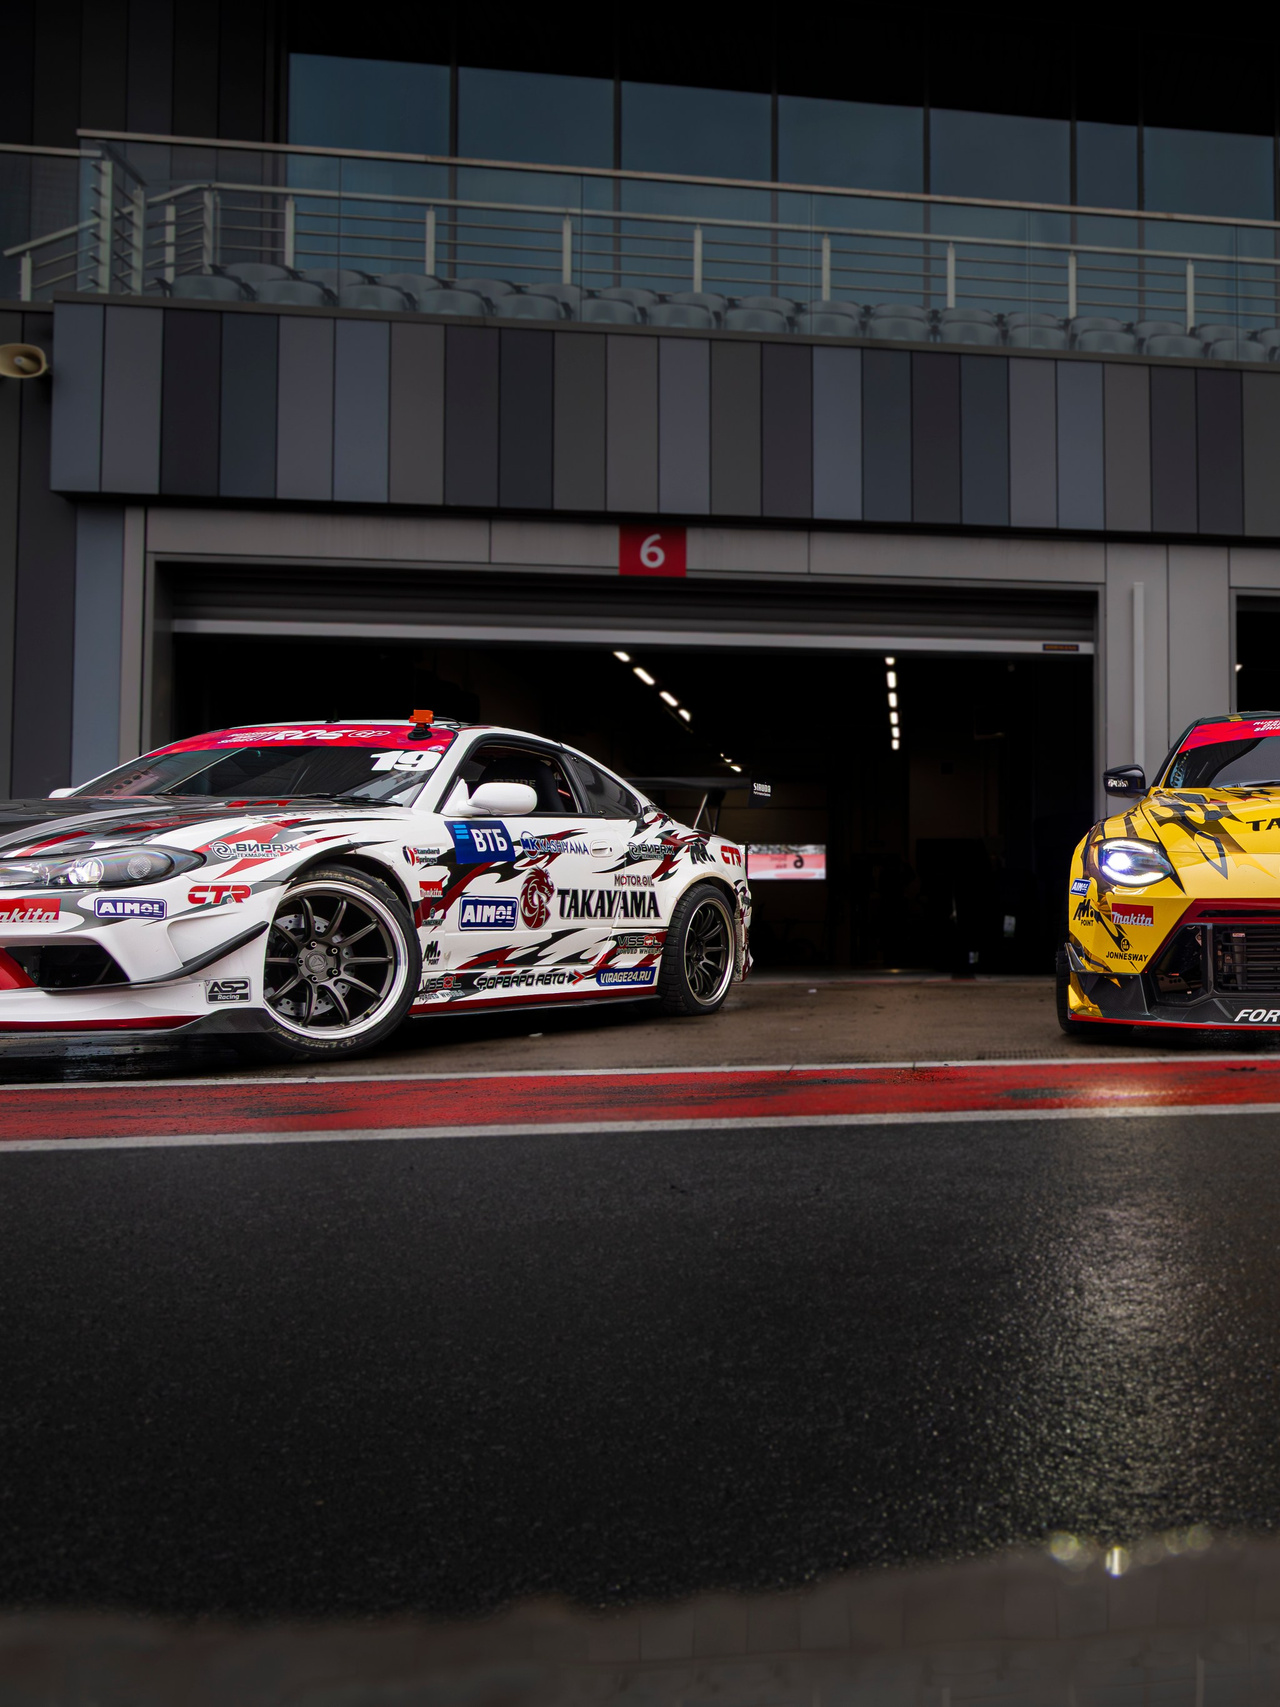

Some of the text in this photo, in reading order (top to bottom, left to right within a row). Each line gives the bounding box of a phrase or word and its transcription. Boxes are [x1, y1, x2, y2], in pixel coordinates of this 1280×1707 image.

[640, 533, 665, 568] 6
[262, 730, 355, 741] RDS
[371, 750, 442, 771] 19
[470, 829, 508, 852] ВТБ
[520, 838, 590, 855] MK KASHIYAMA
[235, 844, 300, 852] ВИРАЖ
[415, 857, 437, 865] Springs
[614, 874, 655, 887] MOTOR OIL
[188, 885, 251, 904] CTR
[99, 902, 162, 914] AIMOL
[557, 888, 663, 920] TAKAYAMA
[0, 908, 58, 922] akita
[462, 904, 515, 923] AIMOL
[618, 935, 662, 947] VISSOL
[1106, 951, 1149, 962] JONNESWAY
[601, 970, 652, 984] VIRAGE24.RU
[208, 981, 249, 993] ASP
